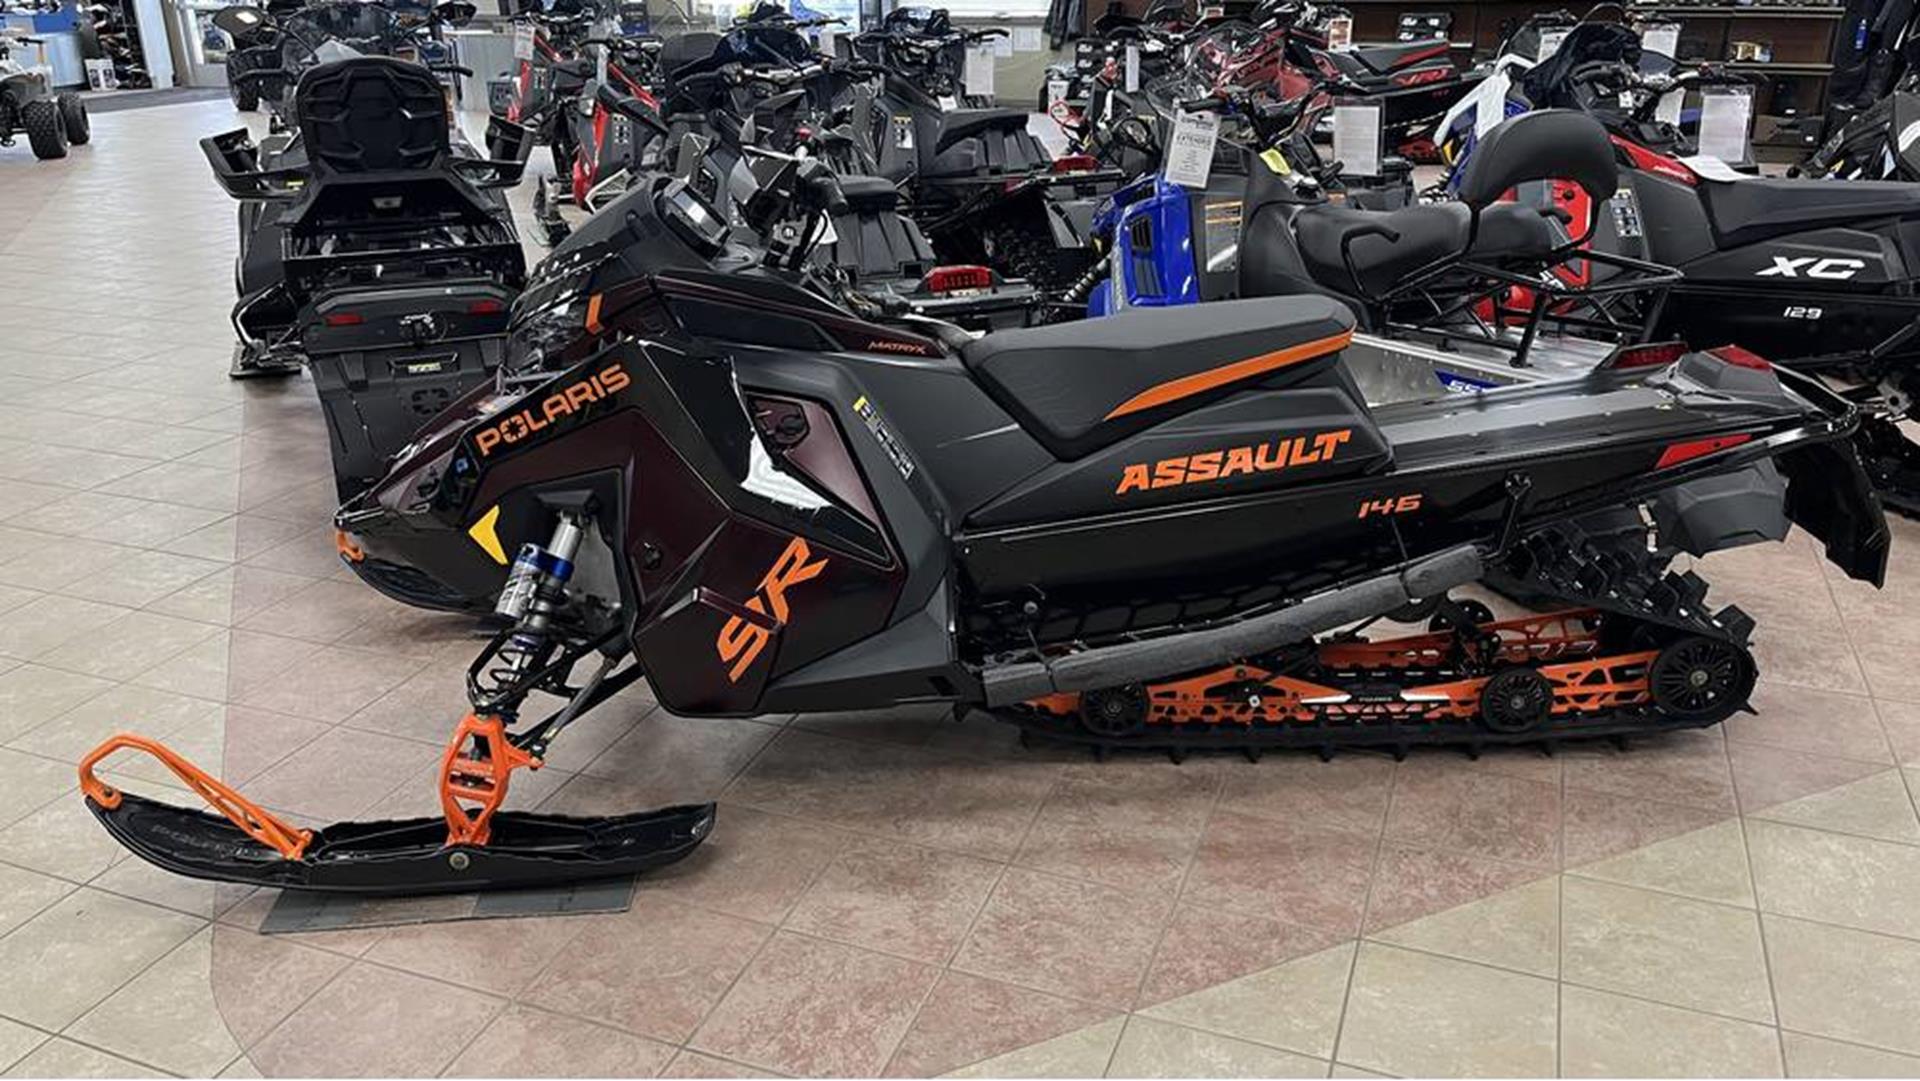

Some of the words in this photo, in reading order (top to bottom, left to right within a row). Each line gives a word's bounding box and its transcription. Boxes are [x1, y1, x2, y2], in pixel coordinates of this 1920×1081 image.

[1754, 256, 1865, 279] XC
[1783, 306, 1822, 319] 129
[868, 341, 925, 354] MATRYX
[475, 364, 631, 456] POLARIS
[1116, 430, 1351, 494] ASSAULT
[1358, 494, 1422, 518] 146
